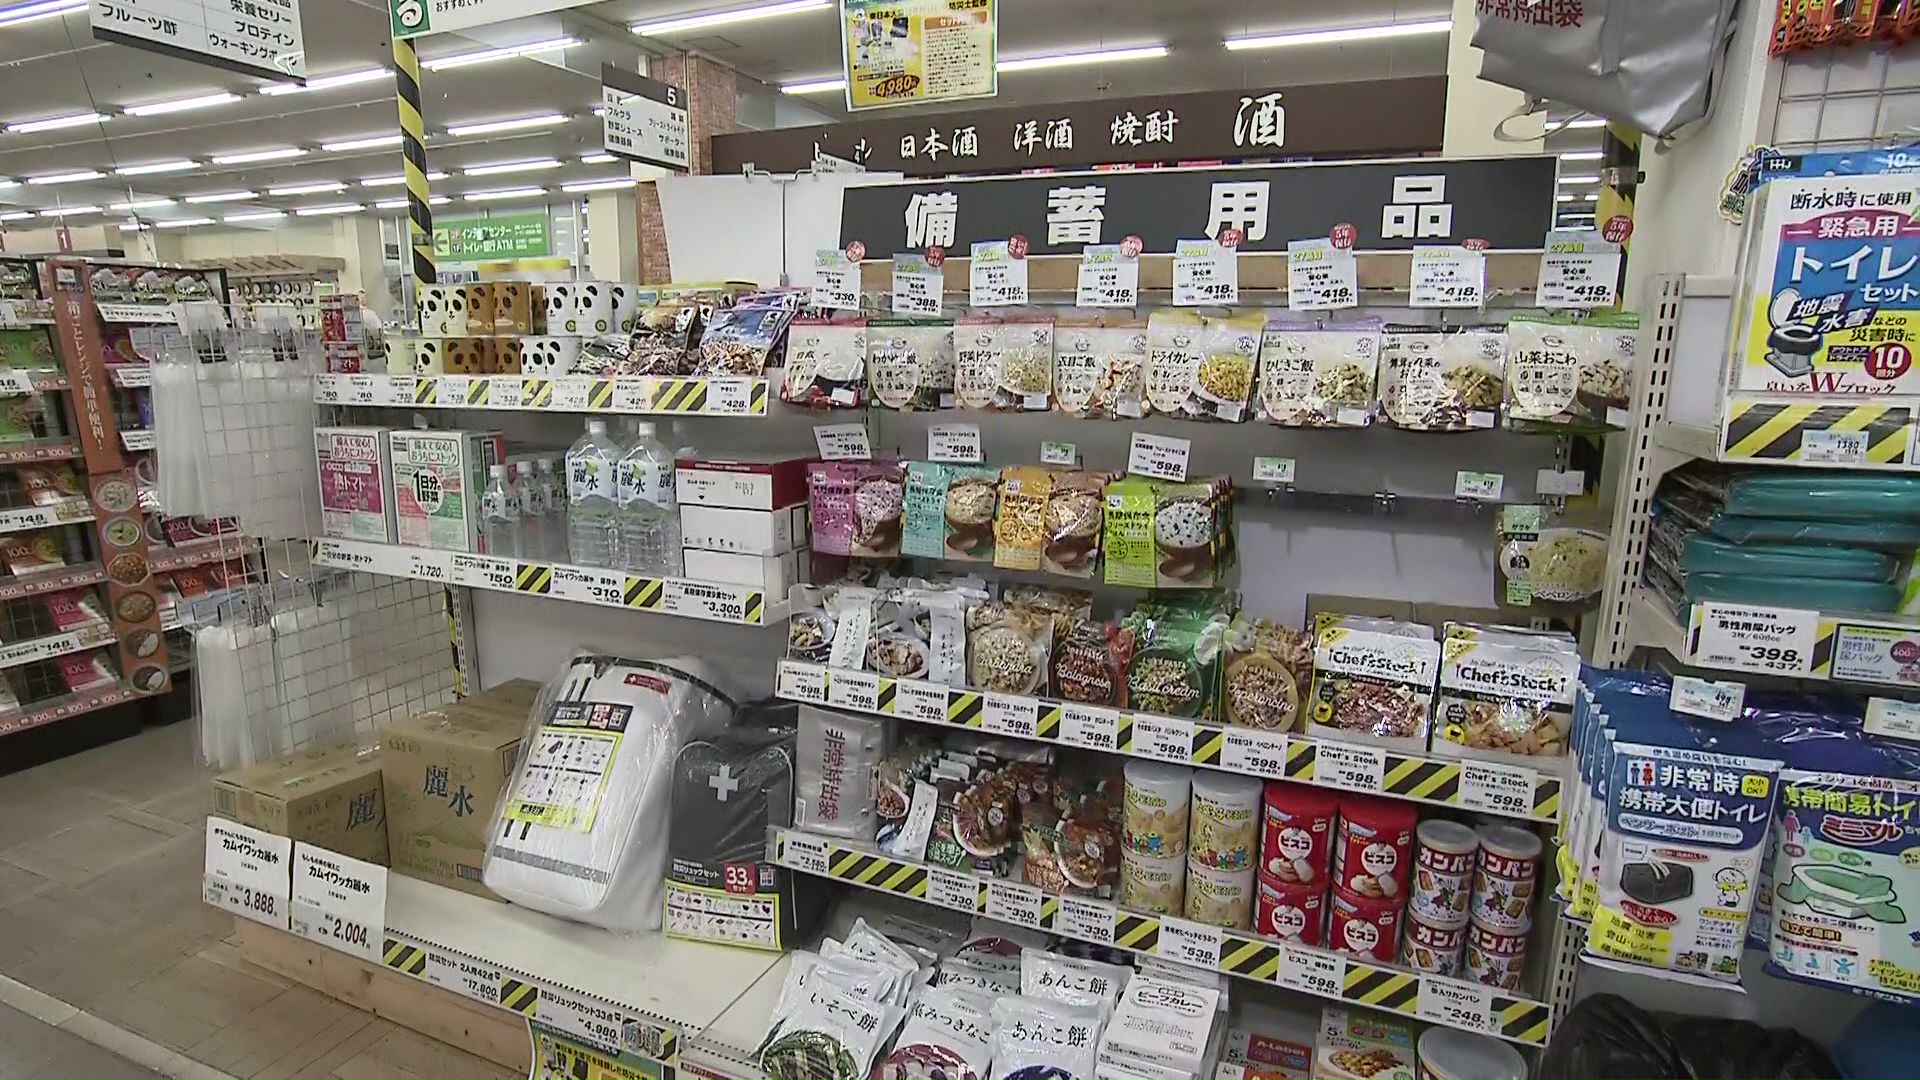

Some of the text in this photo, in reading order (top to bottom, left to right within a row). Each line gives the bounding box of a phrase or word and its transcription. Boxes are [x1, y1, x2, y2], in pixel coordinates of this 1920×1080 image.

[99, 2, 178, 37] フルーツ酢
[209, 33, 298, 66] ウォーキングポル
[666, 87, 677, 106] 5
[1234, 92, 1285, 148] 酒
[1109, 109, 1179, 147] 焼酎
[900, 127, 978, 161] 日本酒
[1013, 117, 1074, 156] 洋酒
[1790, 191, 1912, 210] 断水時に使用
[1818, 215, 1899, 239] 緊急用
[1790, 245, 1918, 283] トイレ
[1105, 287, 1130, 299] 418
[1204, 284, 1230, 295] 418
[1321, 288, 1350, 299] 418
[1574, 285, 1606, 297] 418
[1860, 283, 1919, 303] セット
[1794, 293, 1845, 317] 地震
[1874, 346, 1905, 369] 10
[1156, 460, 1181, 473] 598
[19, 513, 44, 524] 148
[489, 573, 512, 584] 150
[592, 586, 620, 598] 310
[1718, 620, 1797, 635] 男性用尿バッグ
[47, 640, 70, 651] 148
[800, 684, 820, 696] 598
[851, 694, 873, 705] 598
[920, 705, 941, 716] 598
[1008, 720, 1031, 731] 598
[1086, 732, 1111, 743] 598
[1159, 744, 1186, 755] 598
[1250, 757, 1279, 769] 598
[817, 728, 845, 821] 非常持出袋
[1345, 771, 1374, 784] 598
[1465, 771, 1529, 788] Chef's Stock
[1660, 764, 1740, 797] 非常時
[1492, 794, 1524, 807] 598
[1619, 787, 1768, 824] 携帯大便トイレ
[1281, 836, 1310, 852] ビスコ
[1365, 851, 1395, 866] ビスコ
[726, 866, 748, 885] 33
[951, 894, 973, 906] 330
[1011, 909, 1036, 921] 330
[1274, 912, 1304, 927] ビスコ
[1084, 925, 1109, 938] 330
[1346, 927, 1377, 943] ビスコ
[1186, 945, 1213, 960] 538
[1038, 971, 1109, 996] あんこ餅
[1308, 975, 1337, 990] 598
[810, 991, 879, 1034] いそべ餅
[1452, 1008, 1482, 1023] 248
[1012, 1020, 1090, 1048] あんこ餅
